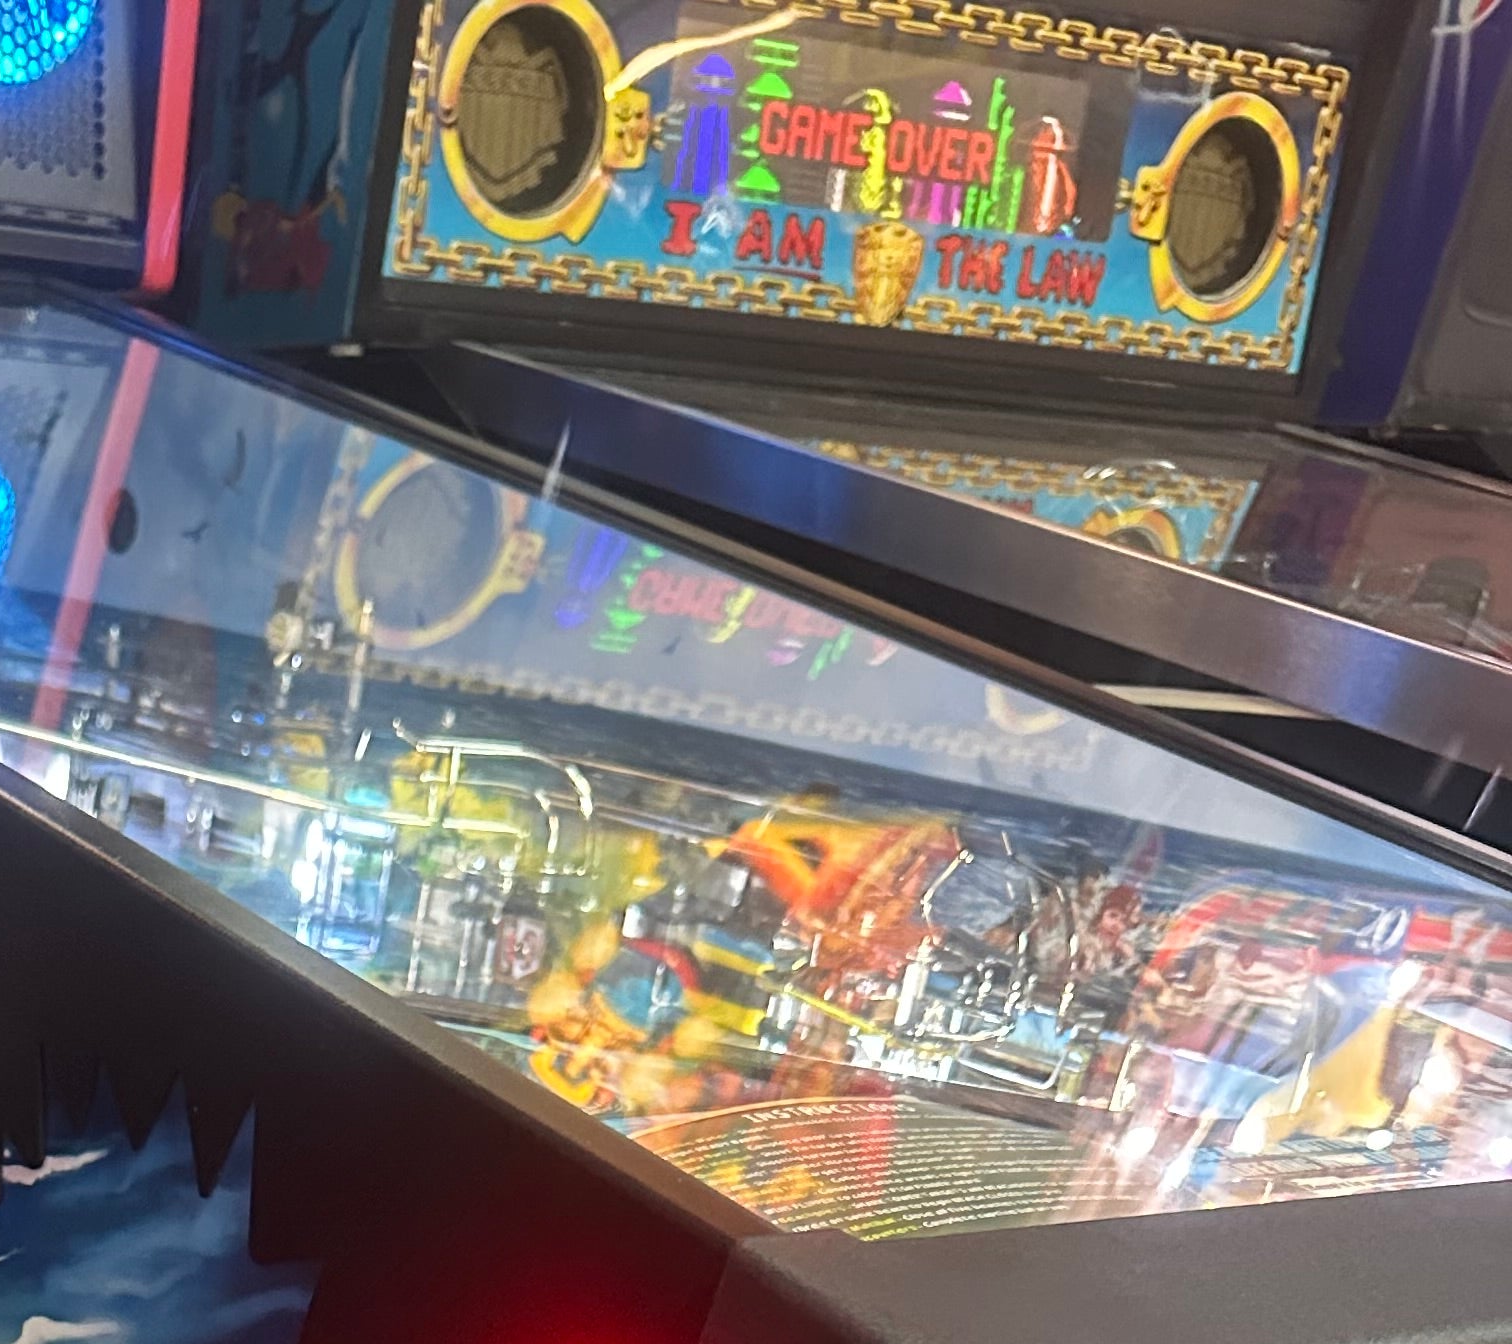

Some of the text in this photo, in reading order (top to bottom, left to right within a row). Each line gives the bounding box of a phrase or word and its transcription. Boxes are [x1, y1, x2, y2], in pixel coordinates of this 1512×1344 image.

[759, 99, 994, 182] GAME OVER
[661, 201, 1106, 308] I AM THE LAW
[741, 1102, 917, 1124] INSTRUCTIONS
